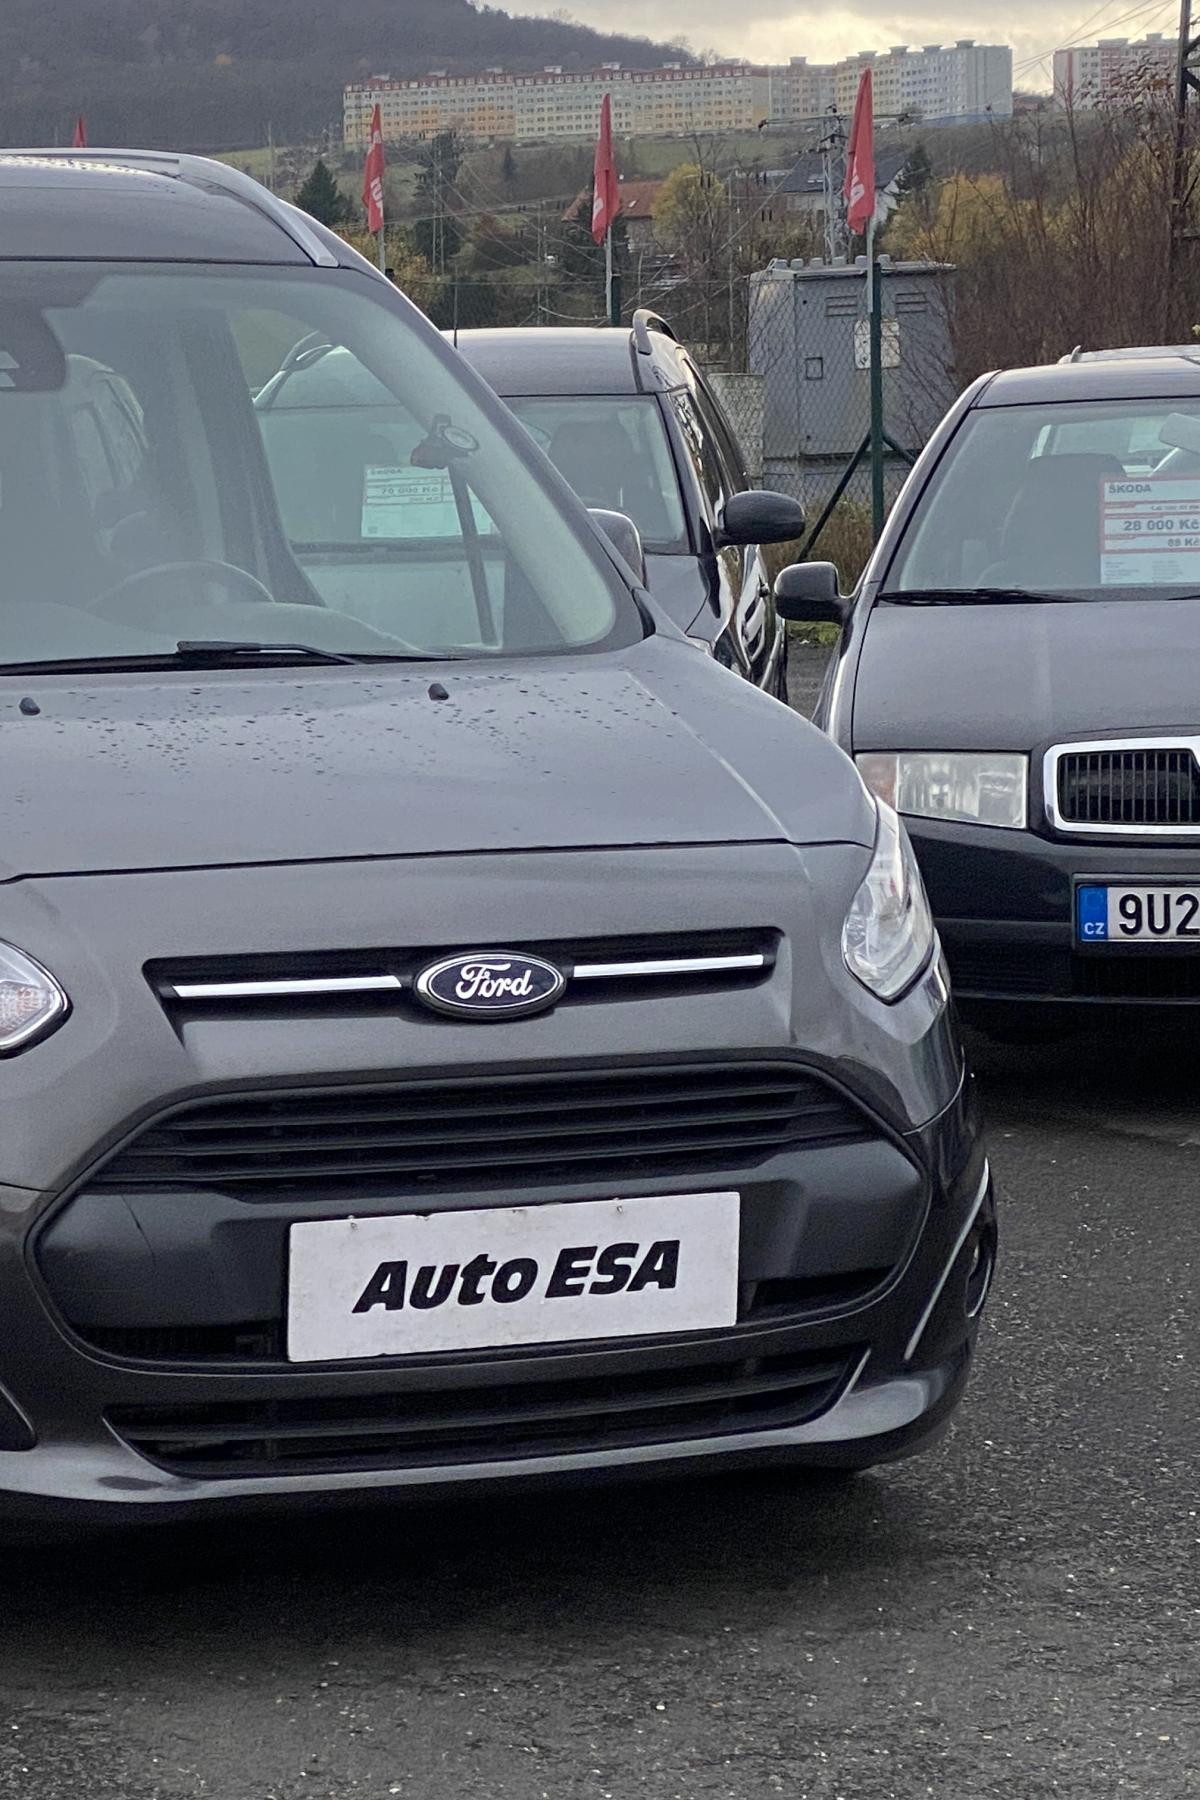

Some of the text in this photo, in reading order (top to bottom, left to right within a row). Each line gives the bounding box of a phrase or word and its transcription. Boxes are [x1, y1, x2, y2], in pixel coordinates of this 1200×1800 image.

[1123, 520, 1141, 531] 28
[1147, 519, 1174, 530] 000
[1084, 893, 1200, 936] CZ 9U2
[455, 962, 534, 999] Ford
[351, 1239, 681, 1314] Auto ESA
